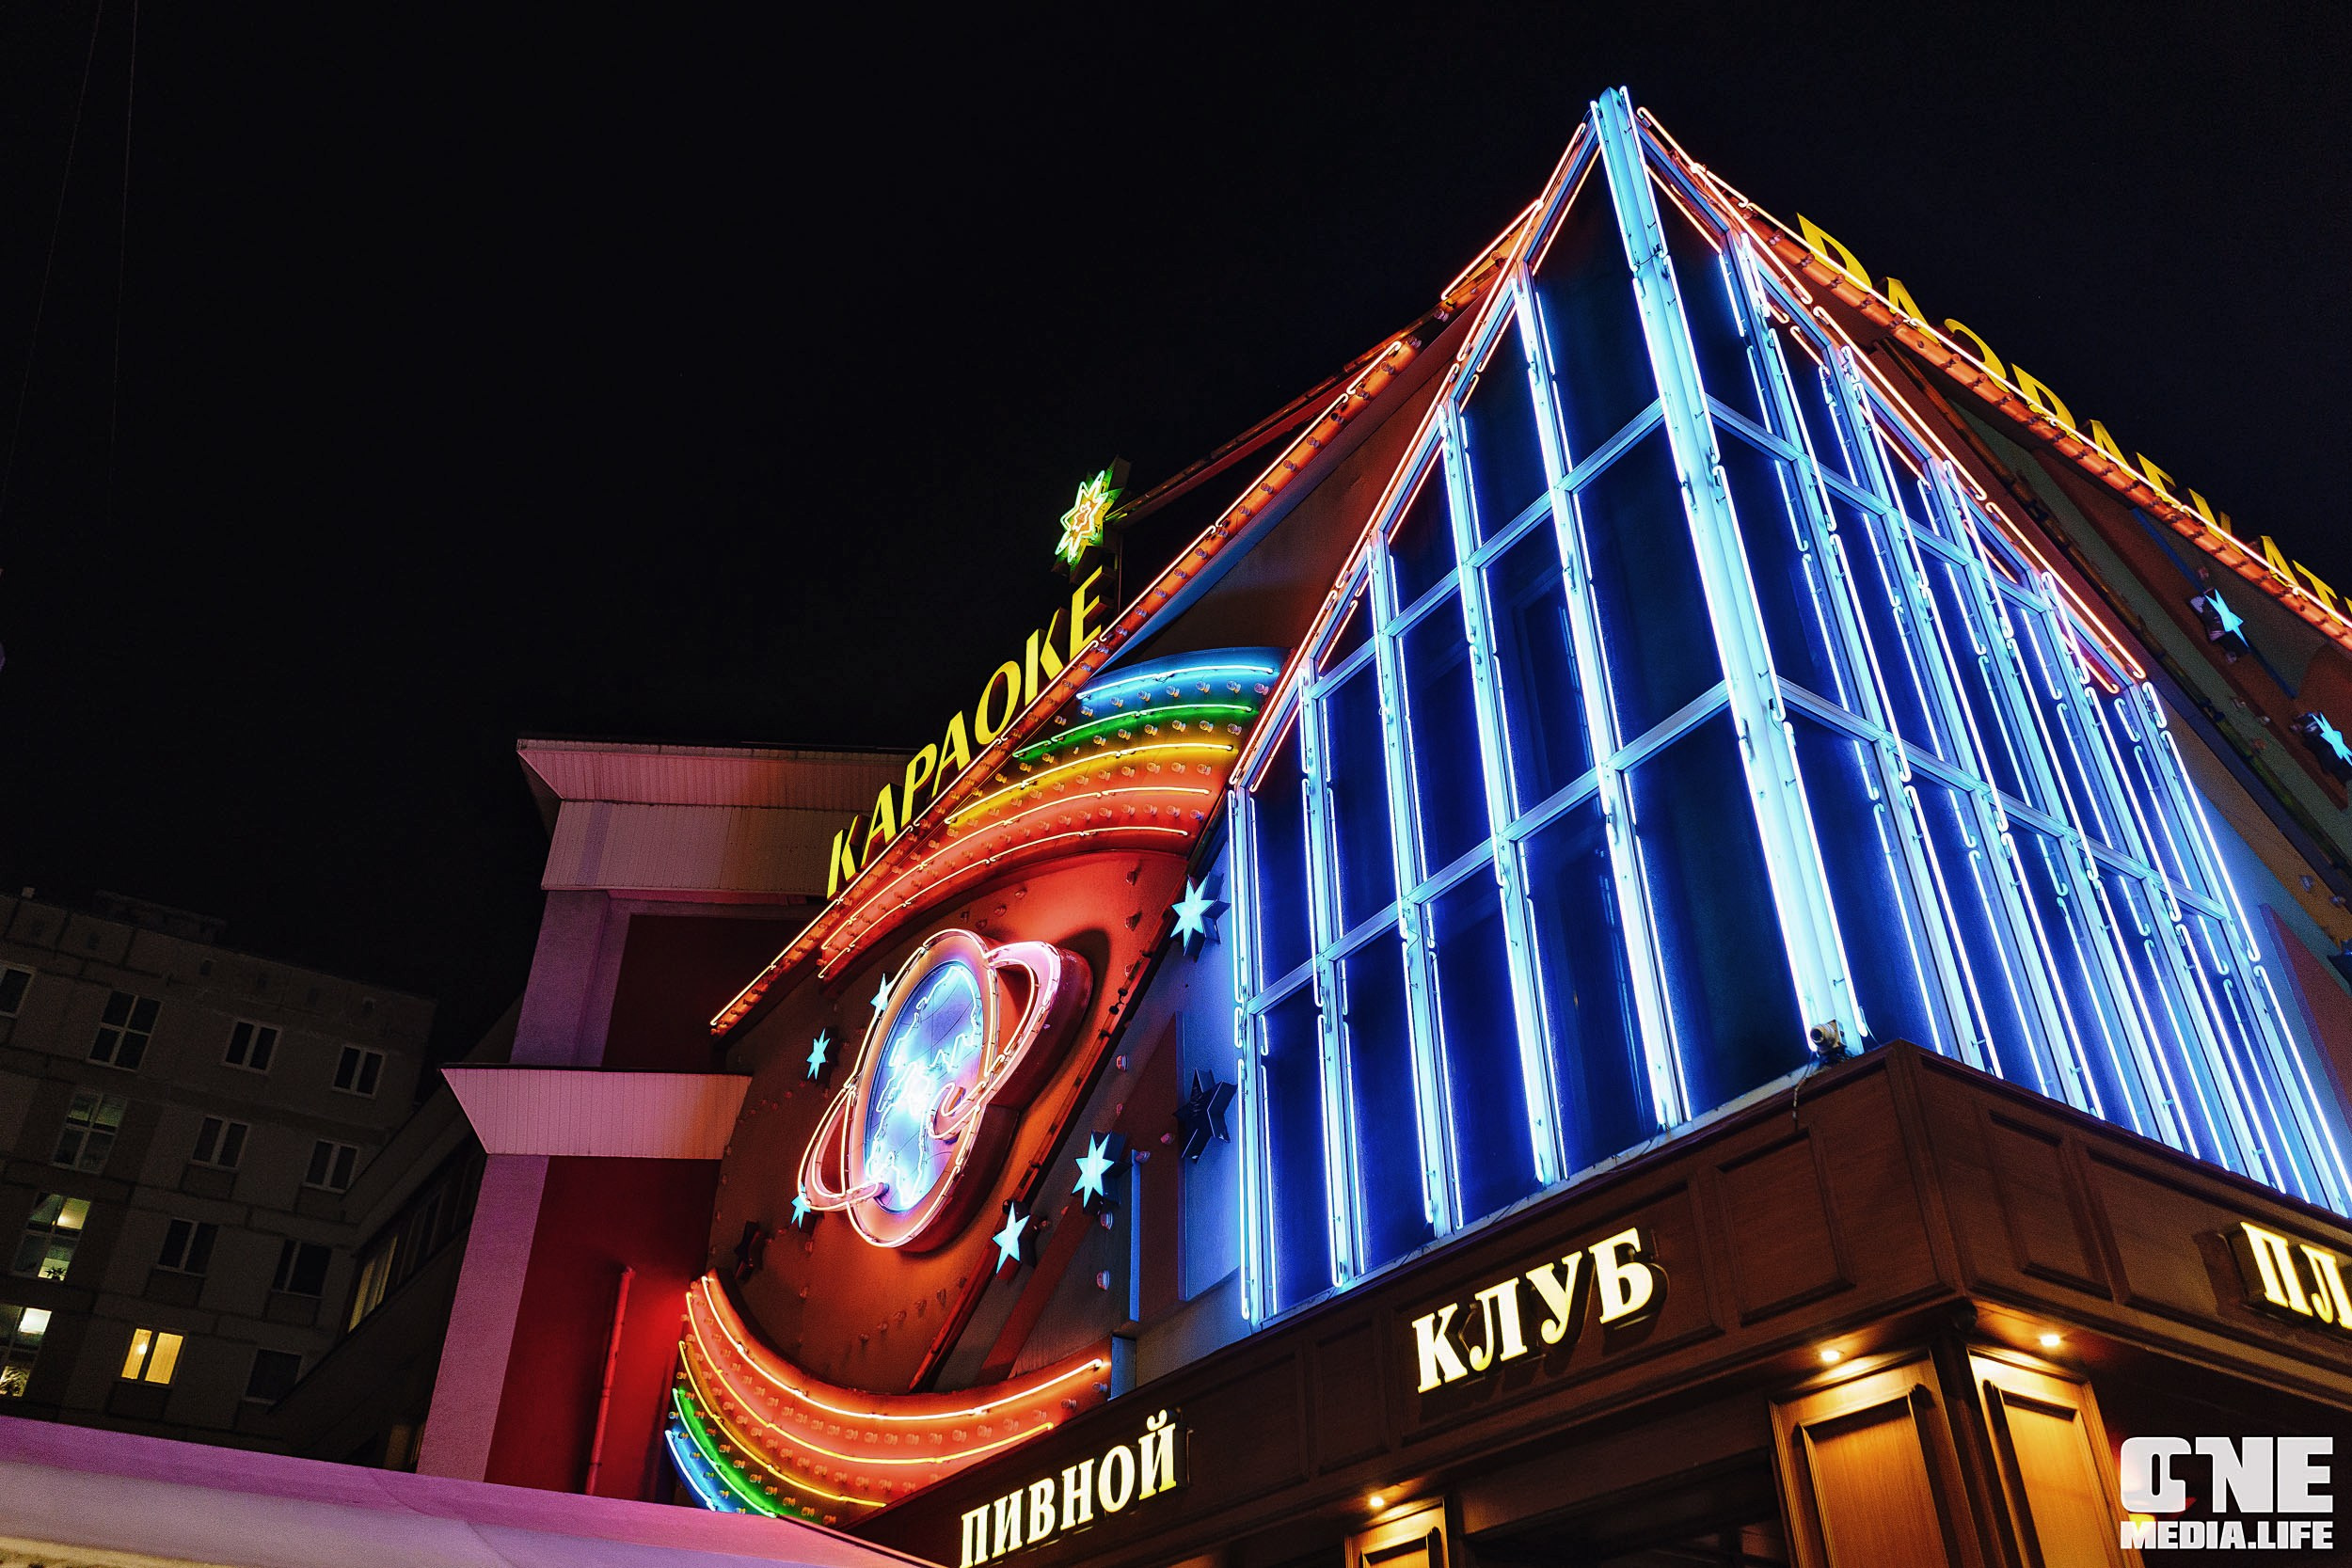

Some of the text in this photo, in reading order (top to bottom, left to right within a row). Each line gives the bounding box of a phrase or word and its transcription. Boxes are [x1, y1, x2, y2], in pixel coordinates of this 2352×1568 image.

[827, 565, 1103, 899] КАРАОКЕ
[960, 1227, 1653, 1568] ПИВНОЙ КЛУБ
